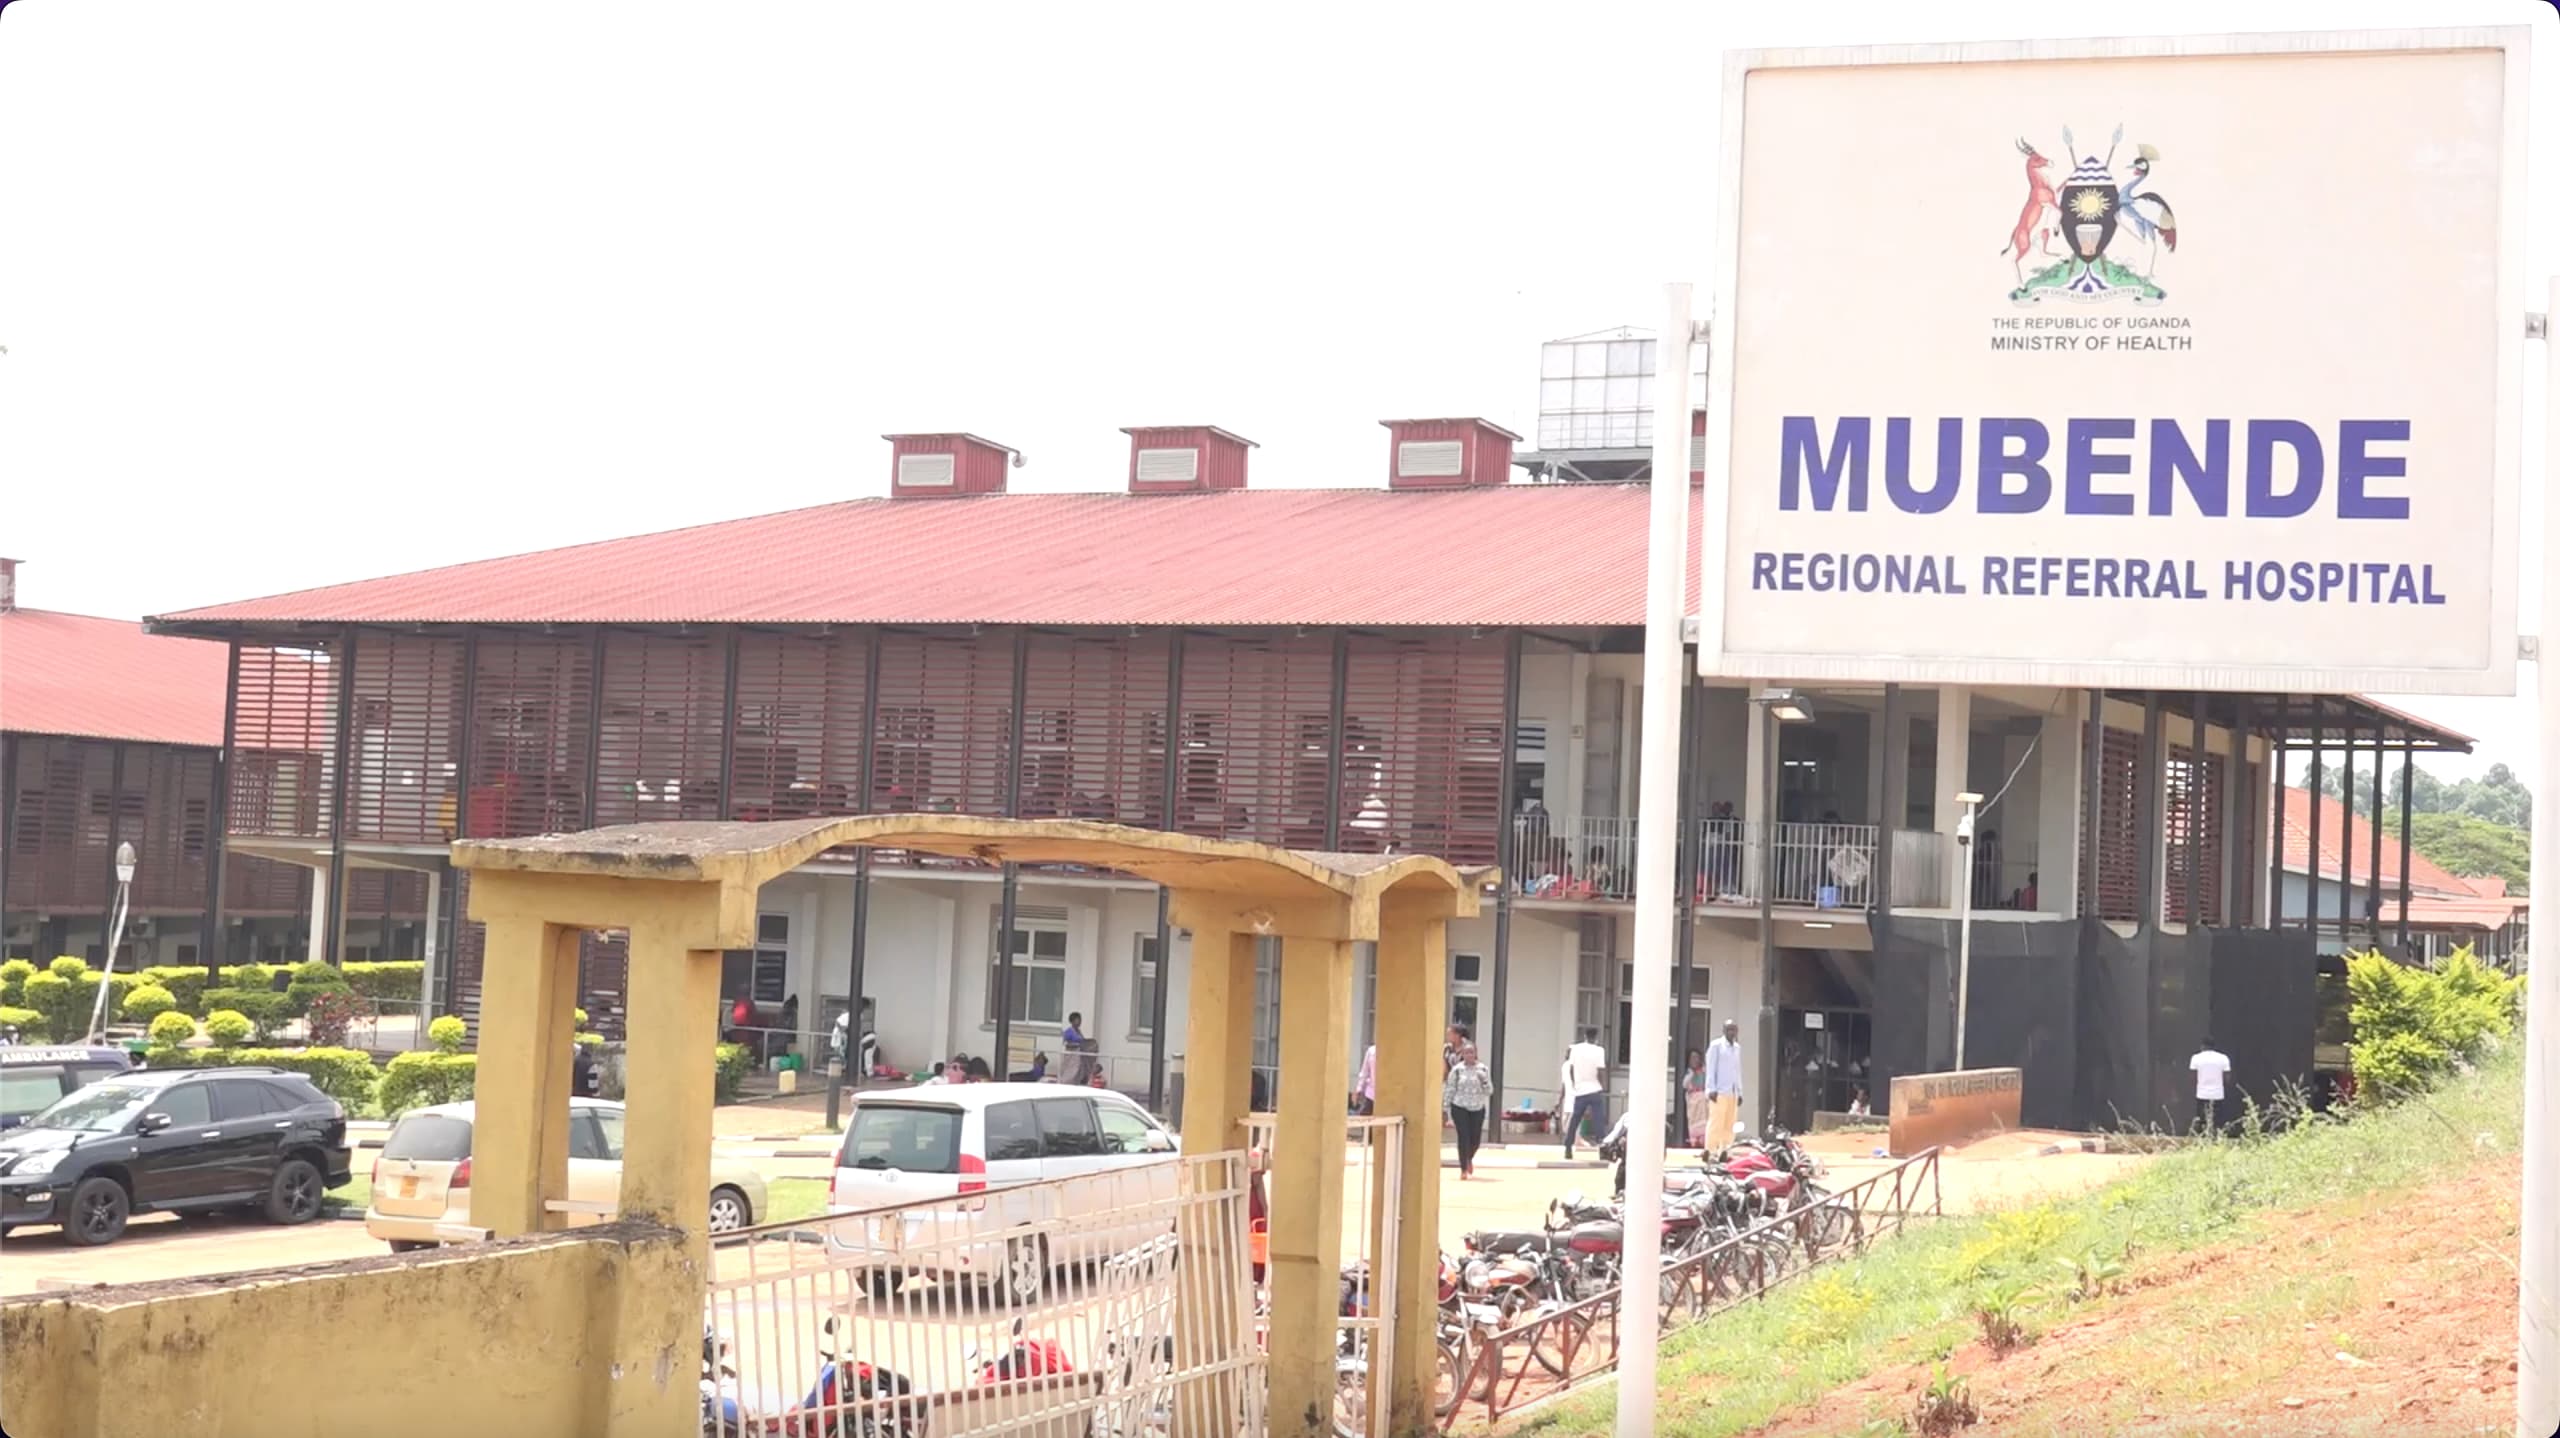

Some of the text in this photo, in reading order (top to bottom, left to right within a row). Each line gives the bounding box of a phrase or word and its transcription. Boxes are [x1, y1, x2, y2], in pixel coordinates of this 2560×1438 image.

[1992, 317, 2191, 329] THE REPUBLIC OF UGANDA
[1991, 336, 2192, 351] MINISTRY OF HEALTH
[1779, 416, 2411, 520] MUBENDE
[1753, 553, 2446, 605] REGIONAL REFERRAL HOSPITAL
[1, 1050, 90, 1063] AMBULANCE
